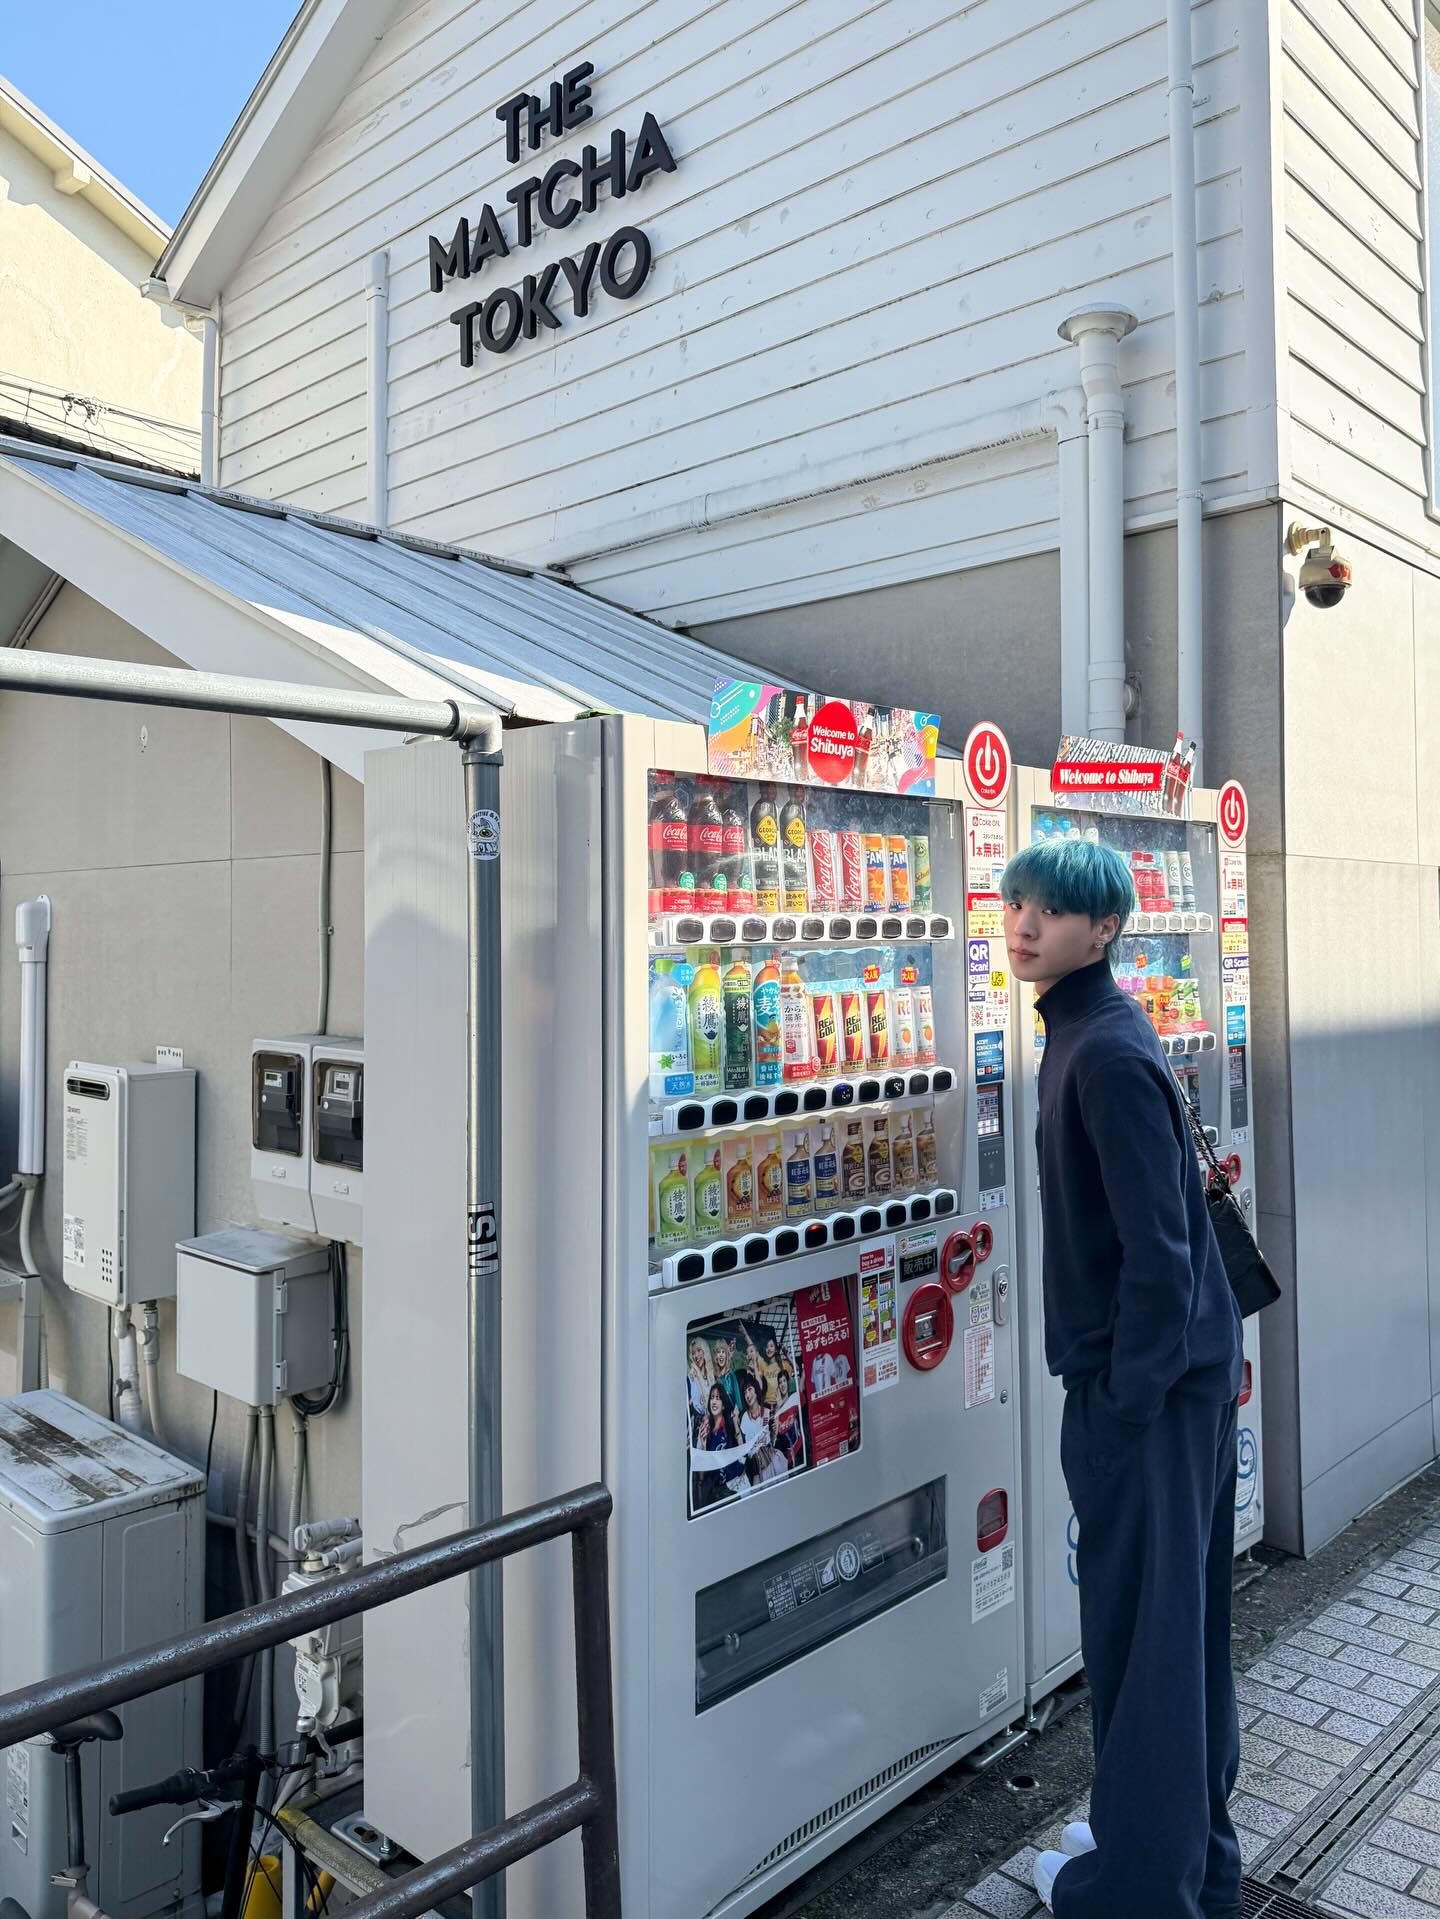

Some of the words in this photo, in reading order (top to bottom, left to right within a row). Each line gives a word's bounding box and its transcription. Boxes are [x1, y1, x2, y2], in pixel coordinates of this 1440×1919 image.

[495, 61, 594, 164] THE
[428, 111, 678, 293] MATCHA
[450, 225, 651, 368] TOKYO
[812, 725, 847, 740] Welcome
[847, 731, 855, 740] to
[810, 737, 854, 760] Shibuya
[1059, 768, 1105, 785] Welcome
[1105, 770, 1117, 785] to
[1117, 768, 1155, 787] Shibuya
[969, 943, 989, 961] QR
[969, 961, 989, 972] Scan!
[1224, 958, 1234, 968] QR
